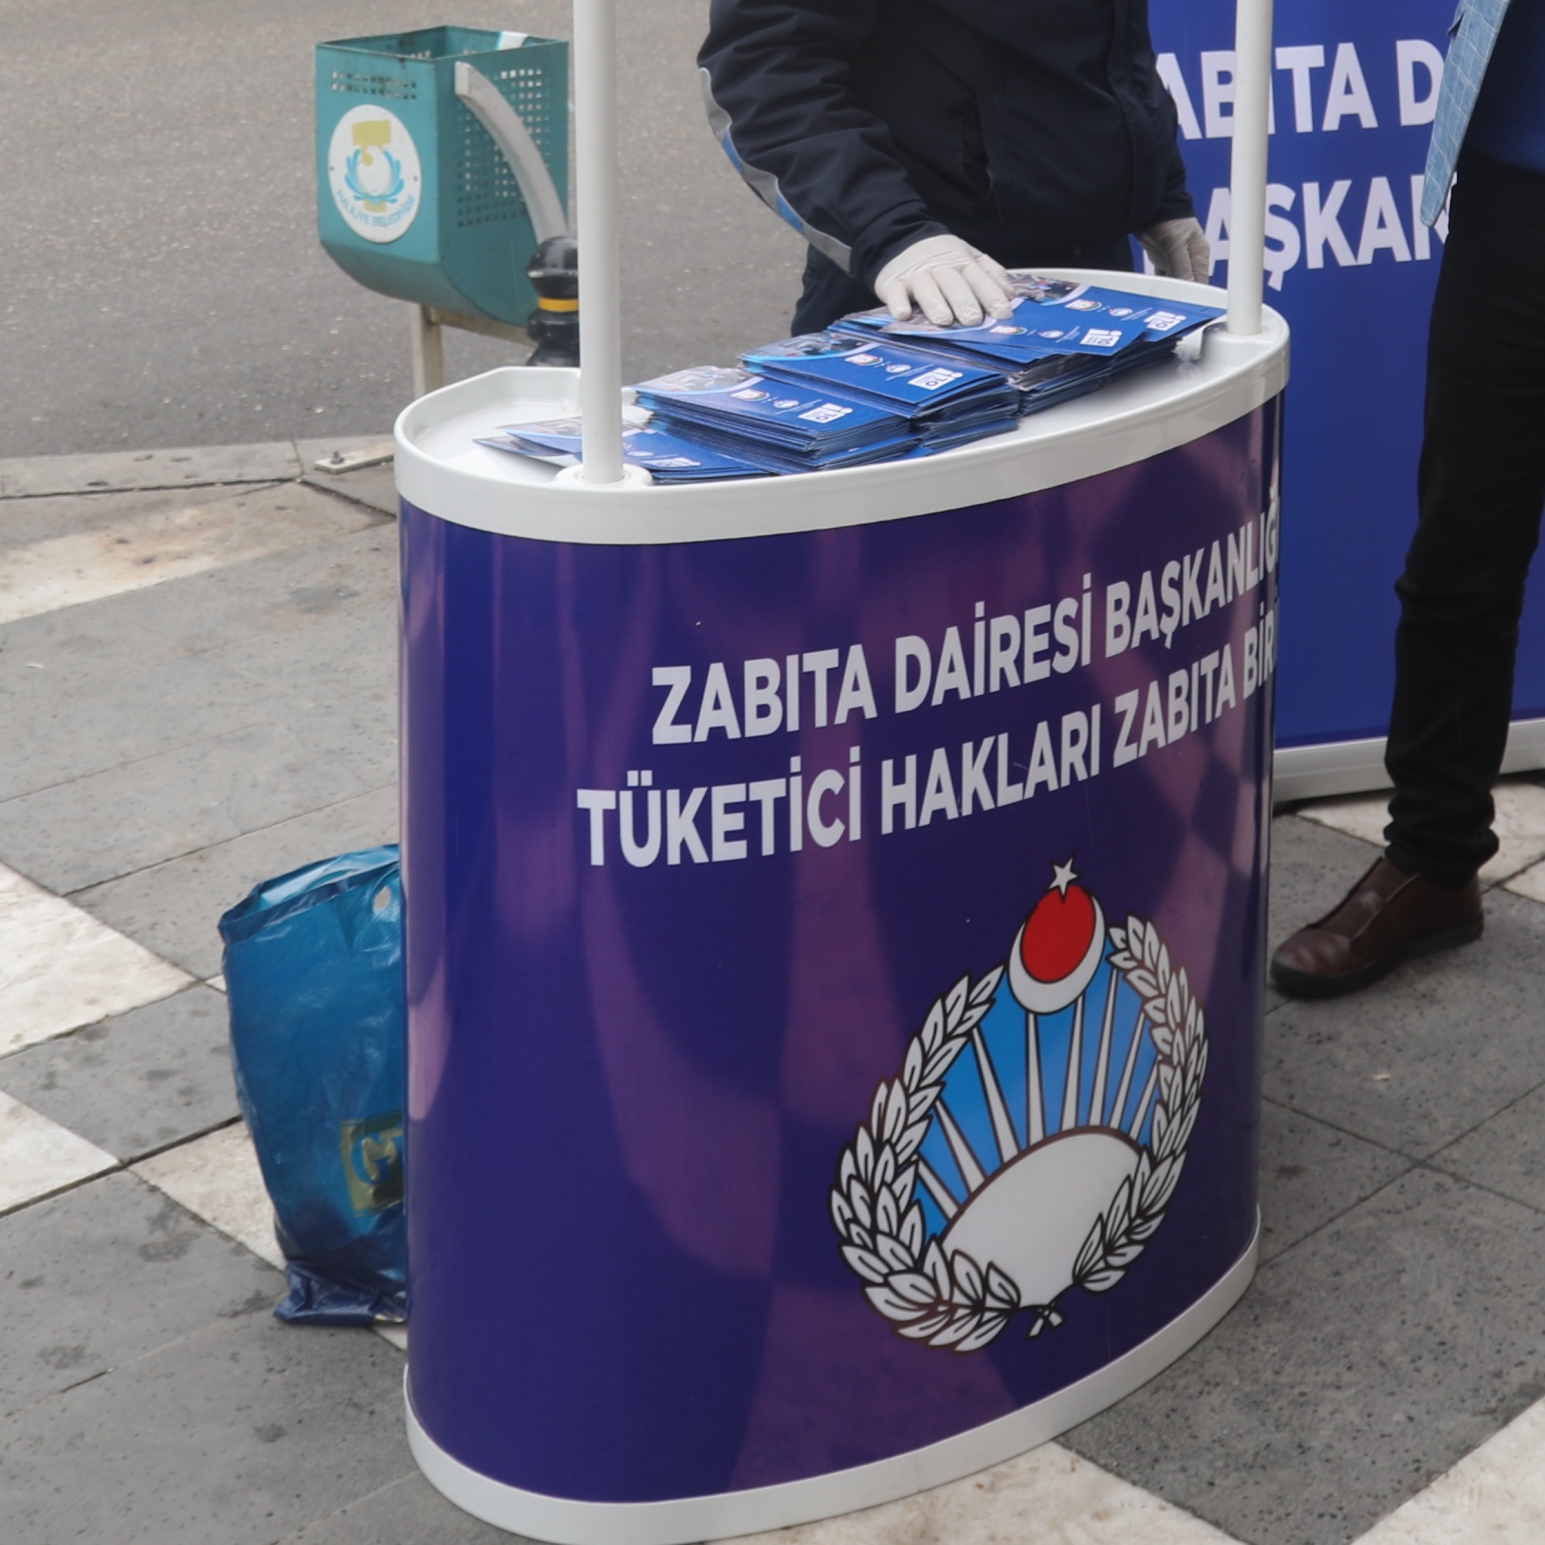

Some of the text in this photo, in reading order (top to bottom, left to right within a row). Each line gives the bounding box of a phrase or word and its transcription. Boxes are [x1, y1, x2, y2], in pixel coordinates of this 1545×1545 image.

[1156, 42, 1378, 141] ABTA
[577, 601, 1275, 868] TÜKETİCİ HAKLARI ZABITA BİR
[652, 642, 877, 745] ZABITA
[894, 573, 1093, 715] DAİRESİ
